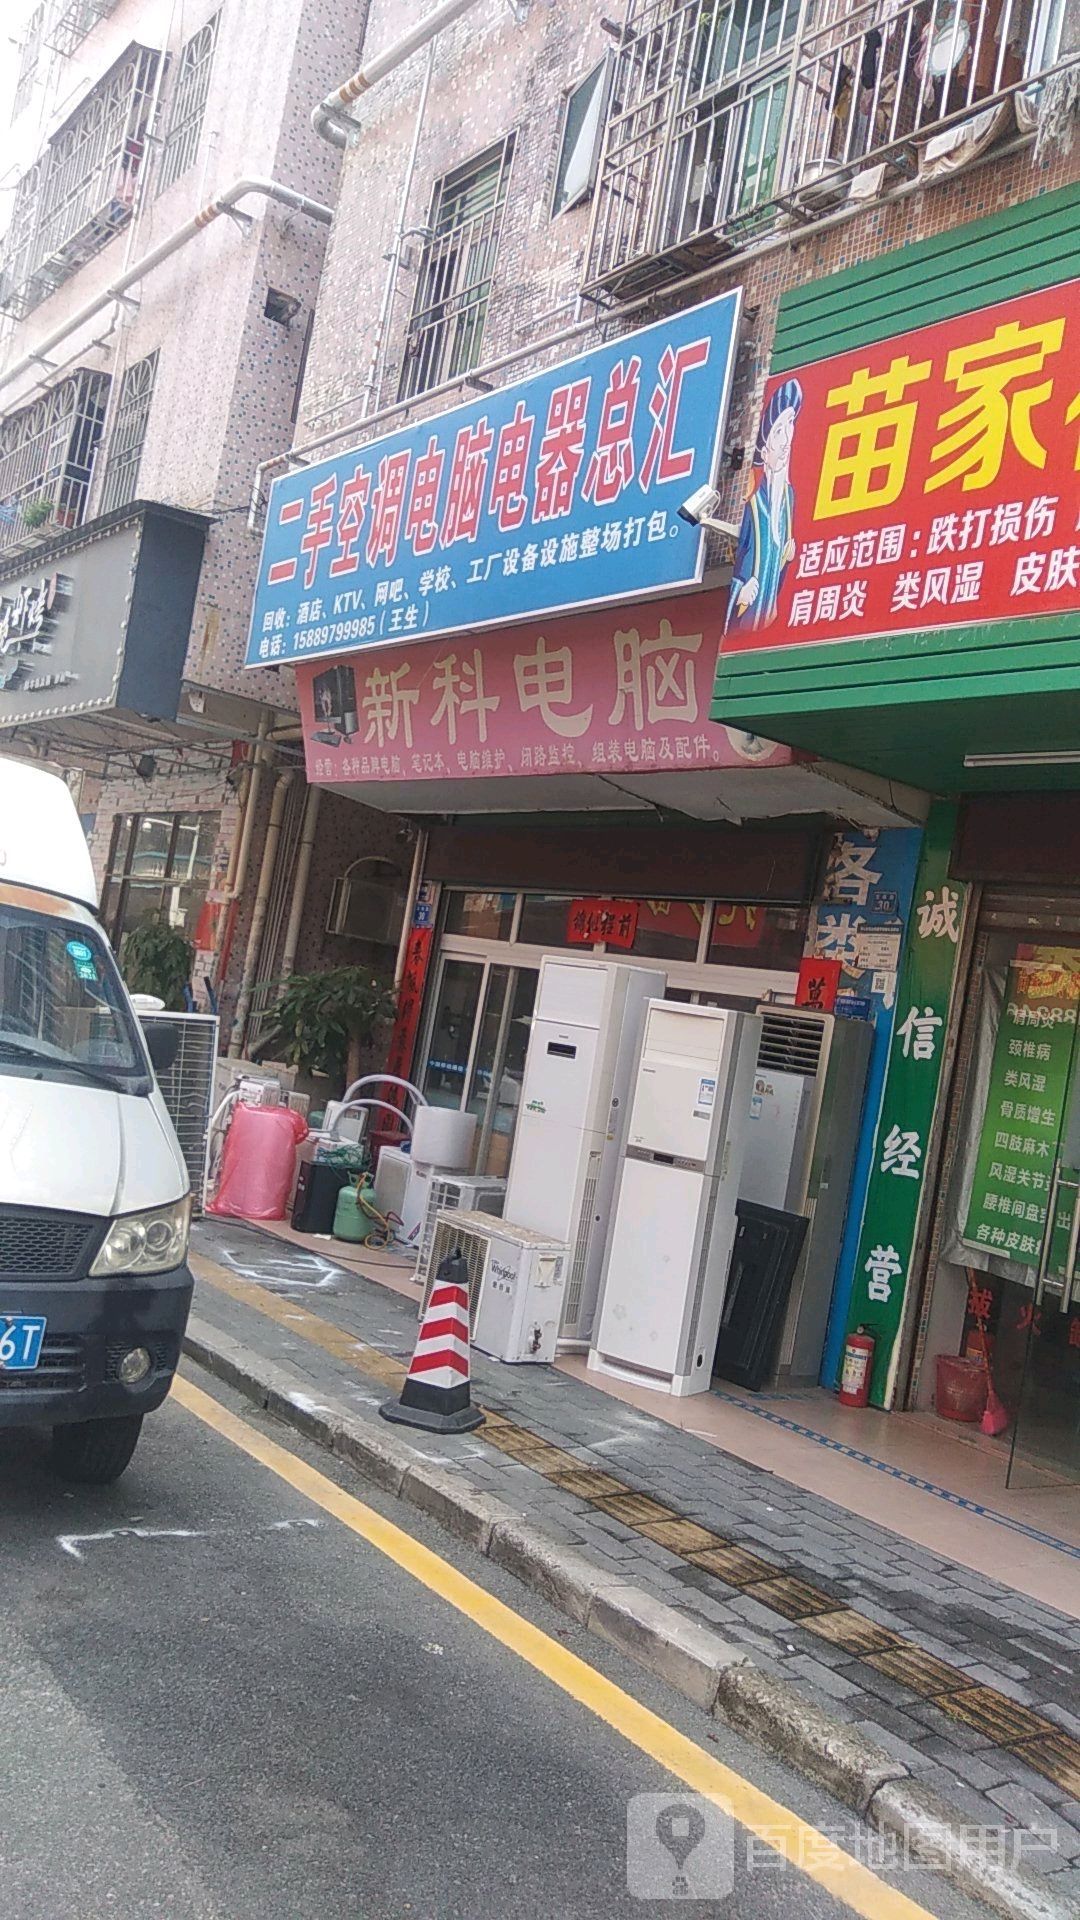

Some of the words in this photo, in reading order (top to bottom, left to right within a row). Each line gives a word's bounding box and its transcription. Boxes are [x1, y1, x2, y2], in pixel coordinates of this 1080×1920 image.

[813, 317, 1080, 520] 苗家
[267, 337, 713, 591] 二手空调电脑电器总汇
[788, 580, 868, 628] 肩周炎
[890, 561, 984, 613] 类风湿
[1009, 545, 1080, 597] 皮肤
[363, 618, 703, 748] 新科电脑
[1009, 1039, 1051, 1061] 颈椎病
[864, 886, 961, 1304] 诚信经营
[1004, 1069, 1046, 1092] 类风湿
[1000, 1100, 1056, 1127] 骨质增生
[994, 1131, 1049, 1158] 四肢麻木
[0, 1325, 41, 1362] 6T
